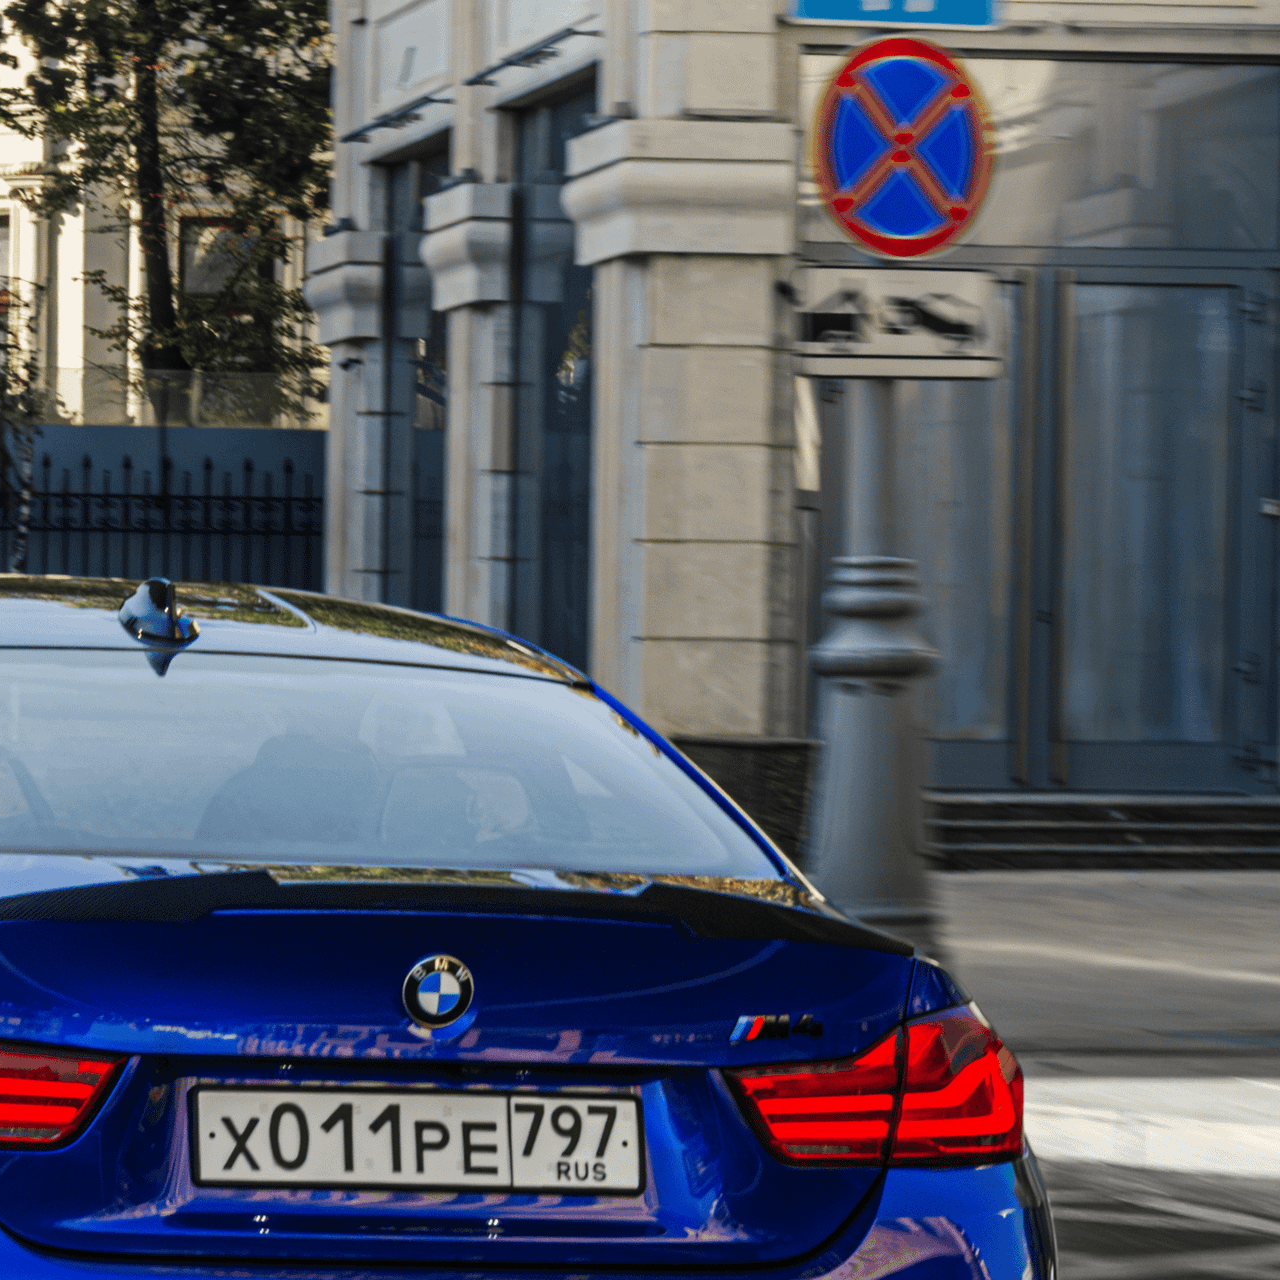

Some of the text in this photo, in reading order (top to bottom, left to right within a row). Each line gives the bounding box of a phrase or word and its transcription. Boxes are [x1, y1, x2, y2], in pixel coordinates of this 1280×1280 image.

[411, 956, 470, 982] BMW
[514, 1103, 618, 1158] 797
[556, 1161, 607, 1182] RUS
